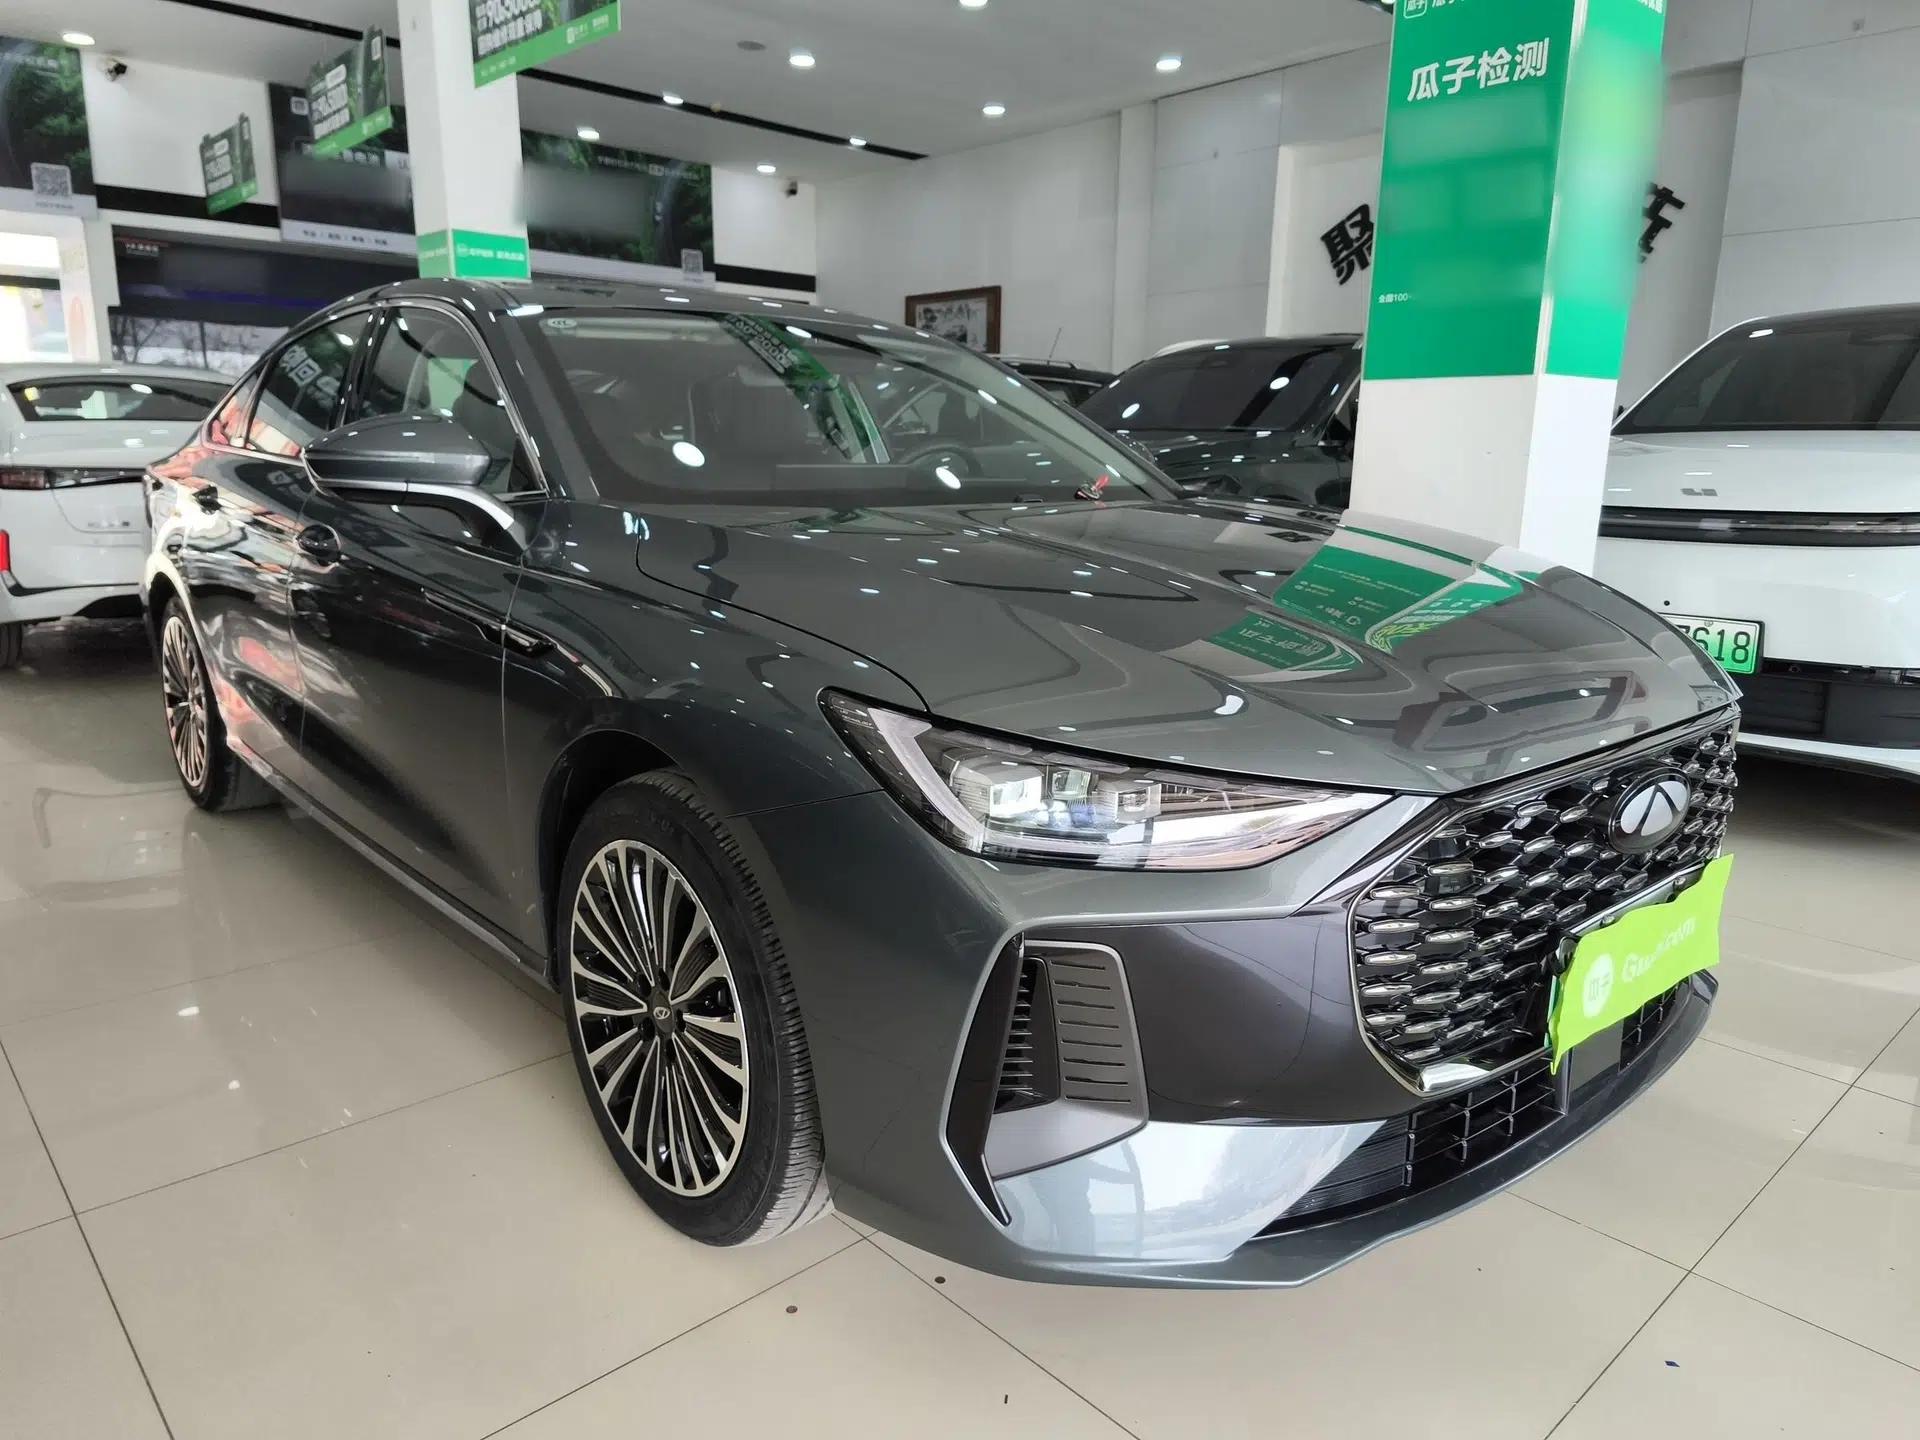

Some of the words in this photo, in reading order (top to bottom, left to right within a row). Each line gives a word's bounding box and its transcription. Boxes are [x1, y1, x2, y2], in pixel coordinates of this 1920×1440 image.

[1407, 38, 1550, 102] 瓜子检测
[1320, 203, 1374, 286] 聚
